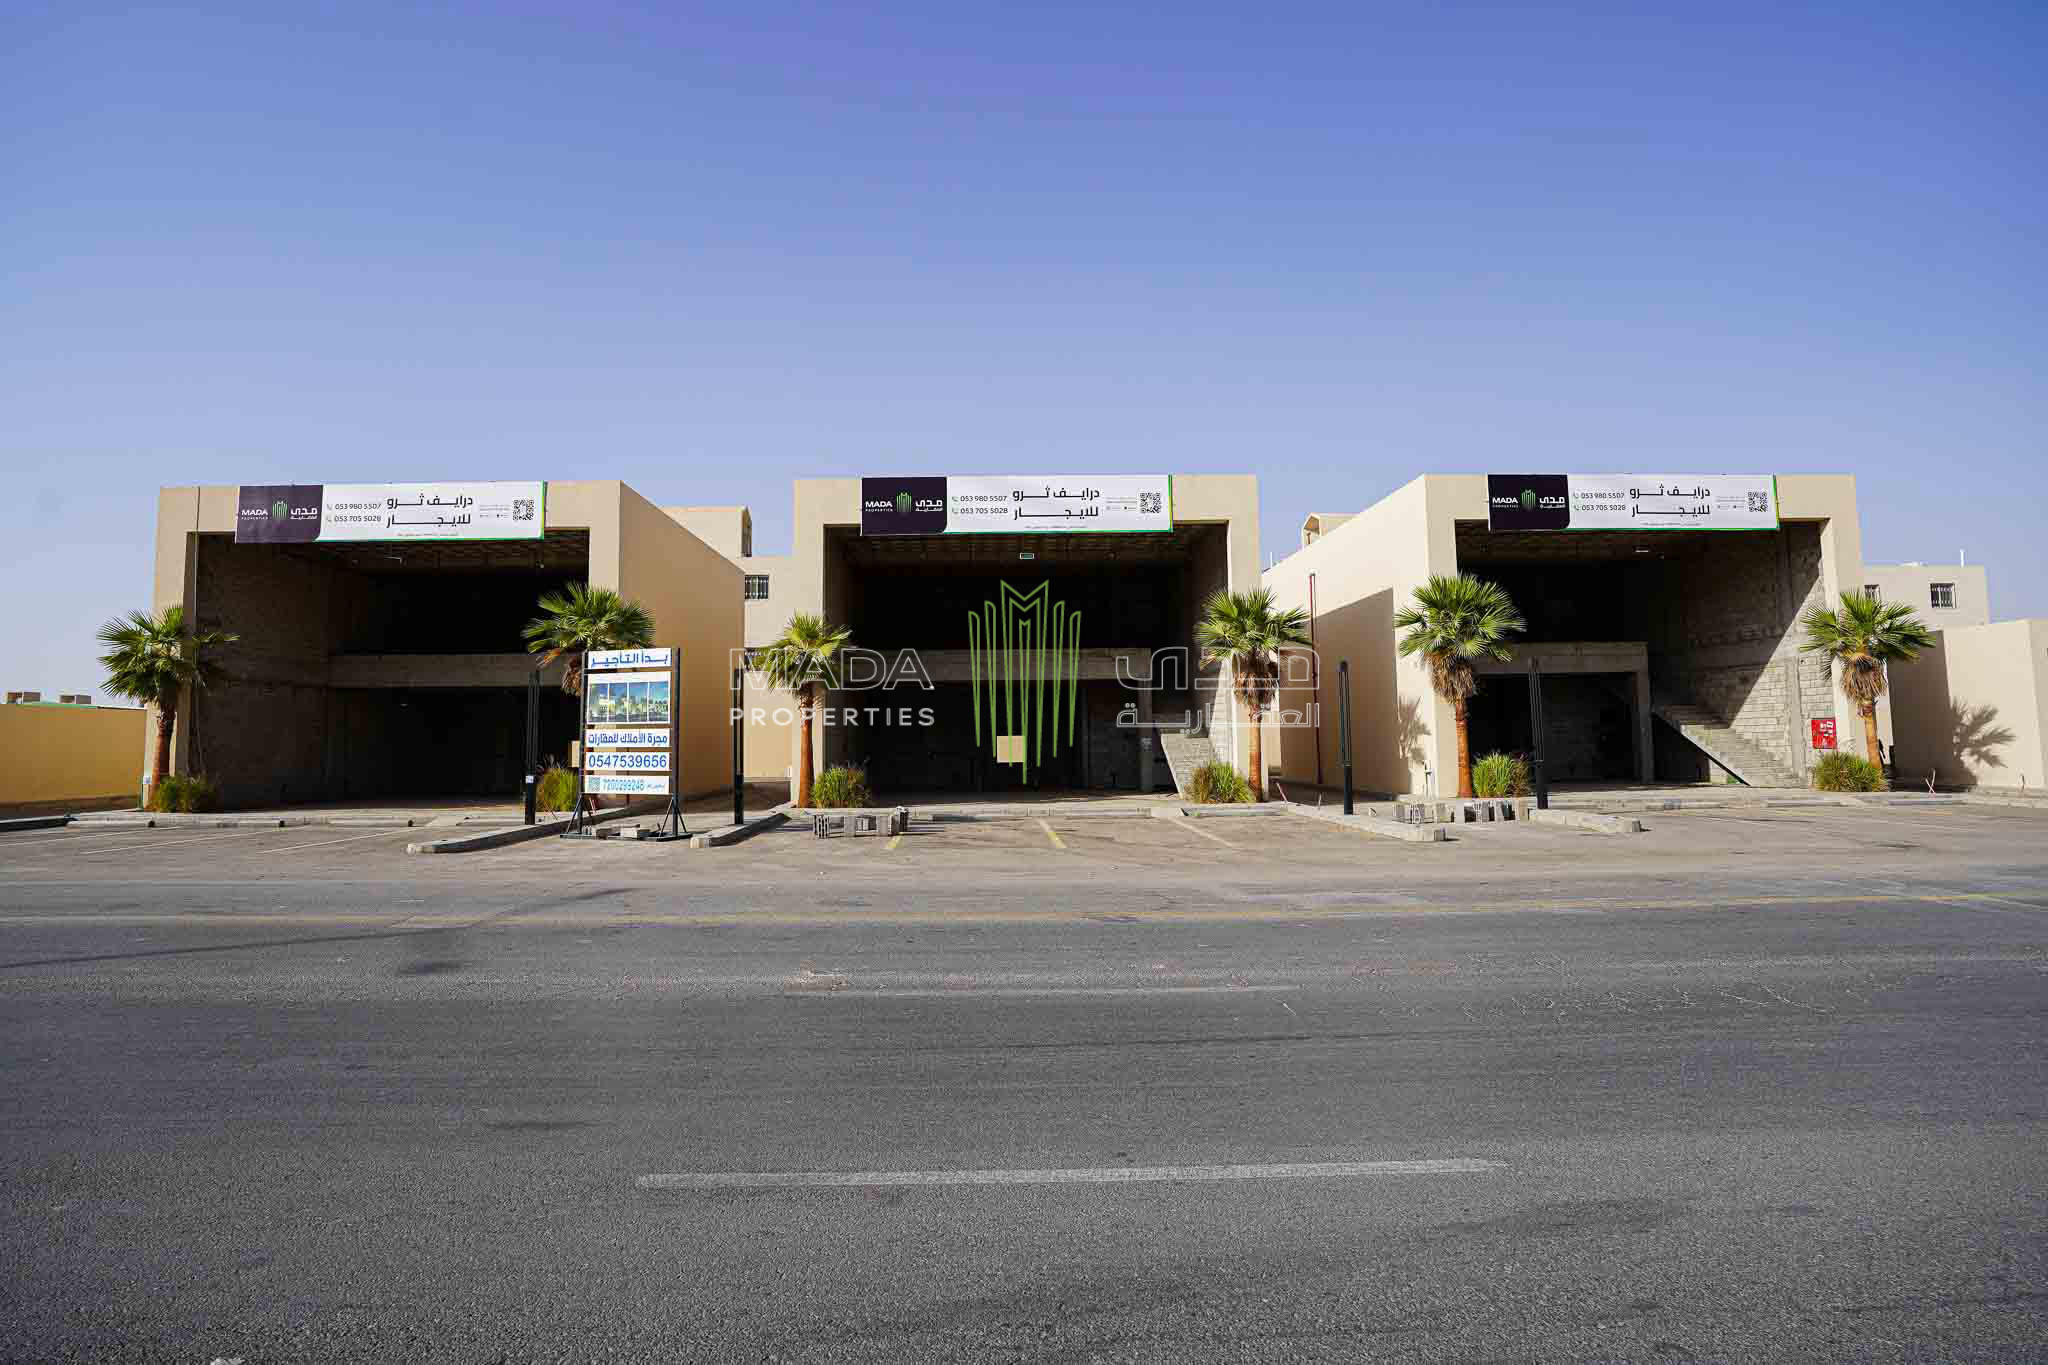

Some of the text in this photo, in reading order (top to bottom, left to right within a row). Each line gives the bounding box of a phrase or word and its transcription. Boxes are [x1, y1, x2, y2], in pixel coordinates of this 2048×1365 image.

[1012, 486, 1100, 501] درايف ثرو
[1629, 484, 1711, 500] درايف ثرو
[386, 493, 473, 509] درايف ثرو
[588, 732, 619, 746] للعقارات
[647, 733, 668, 746] مجرة
[588, 754, 667, 768] 0547539656
